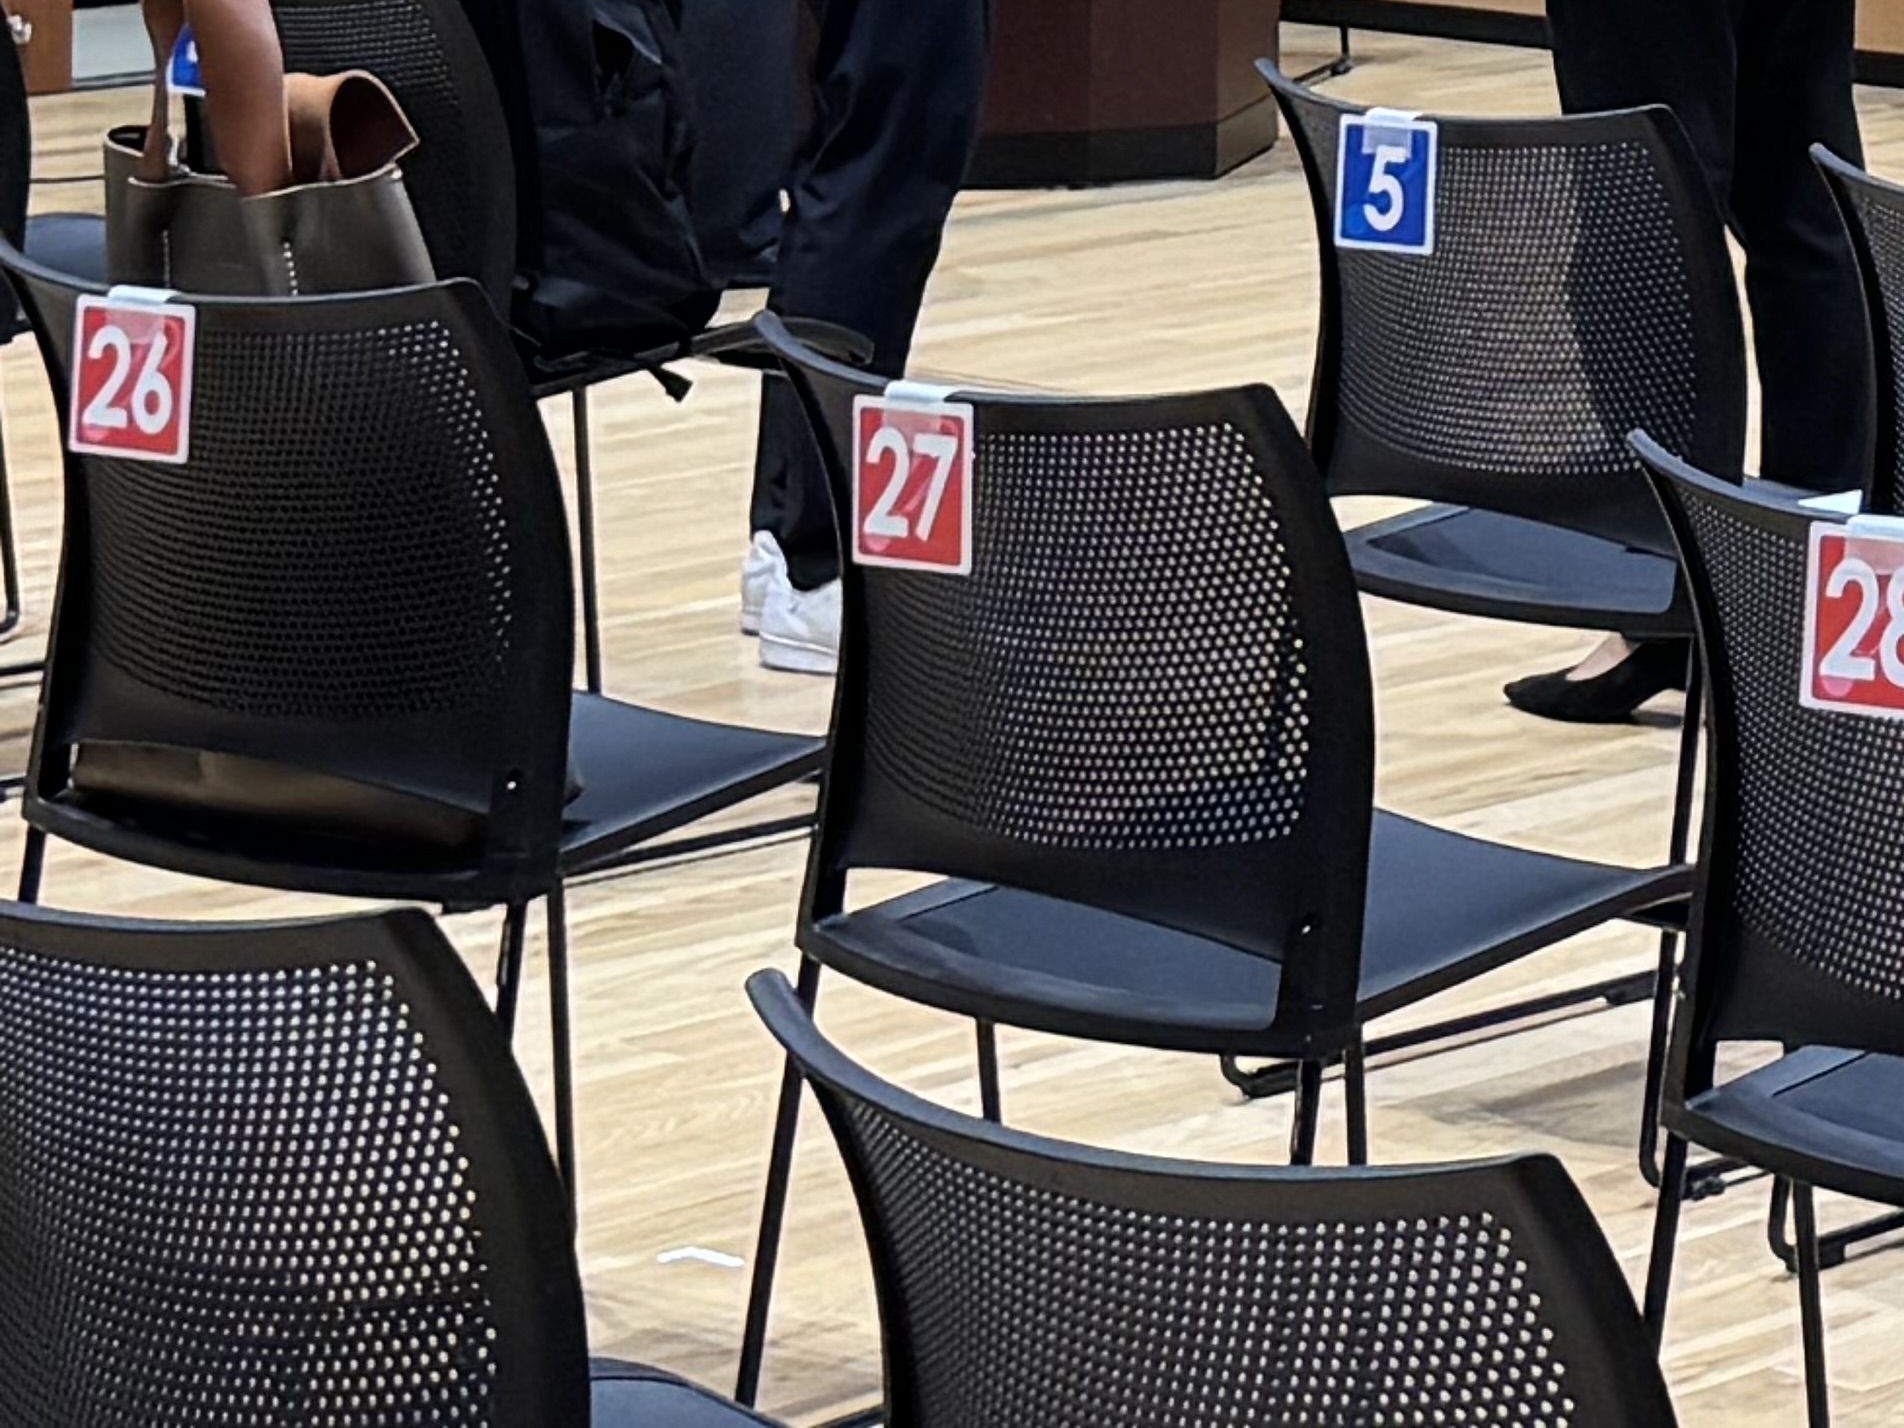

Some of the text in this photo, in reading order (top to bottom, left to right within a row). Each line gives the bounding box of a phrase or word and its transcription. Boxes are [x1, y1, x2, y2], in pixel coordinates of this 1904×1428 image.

[1364, 144, 1411, 232] 5
[80, 324, 173, 435] 26
[863, 427, 958, 542] 27
